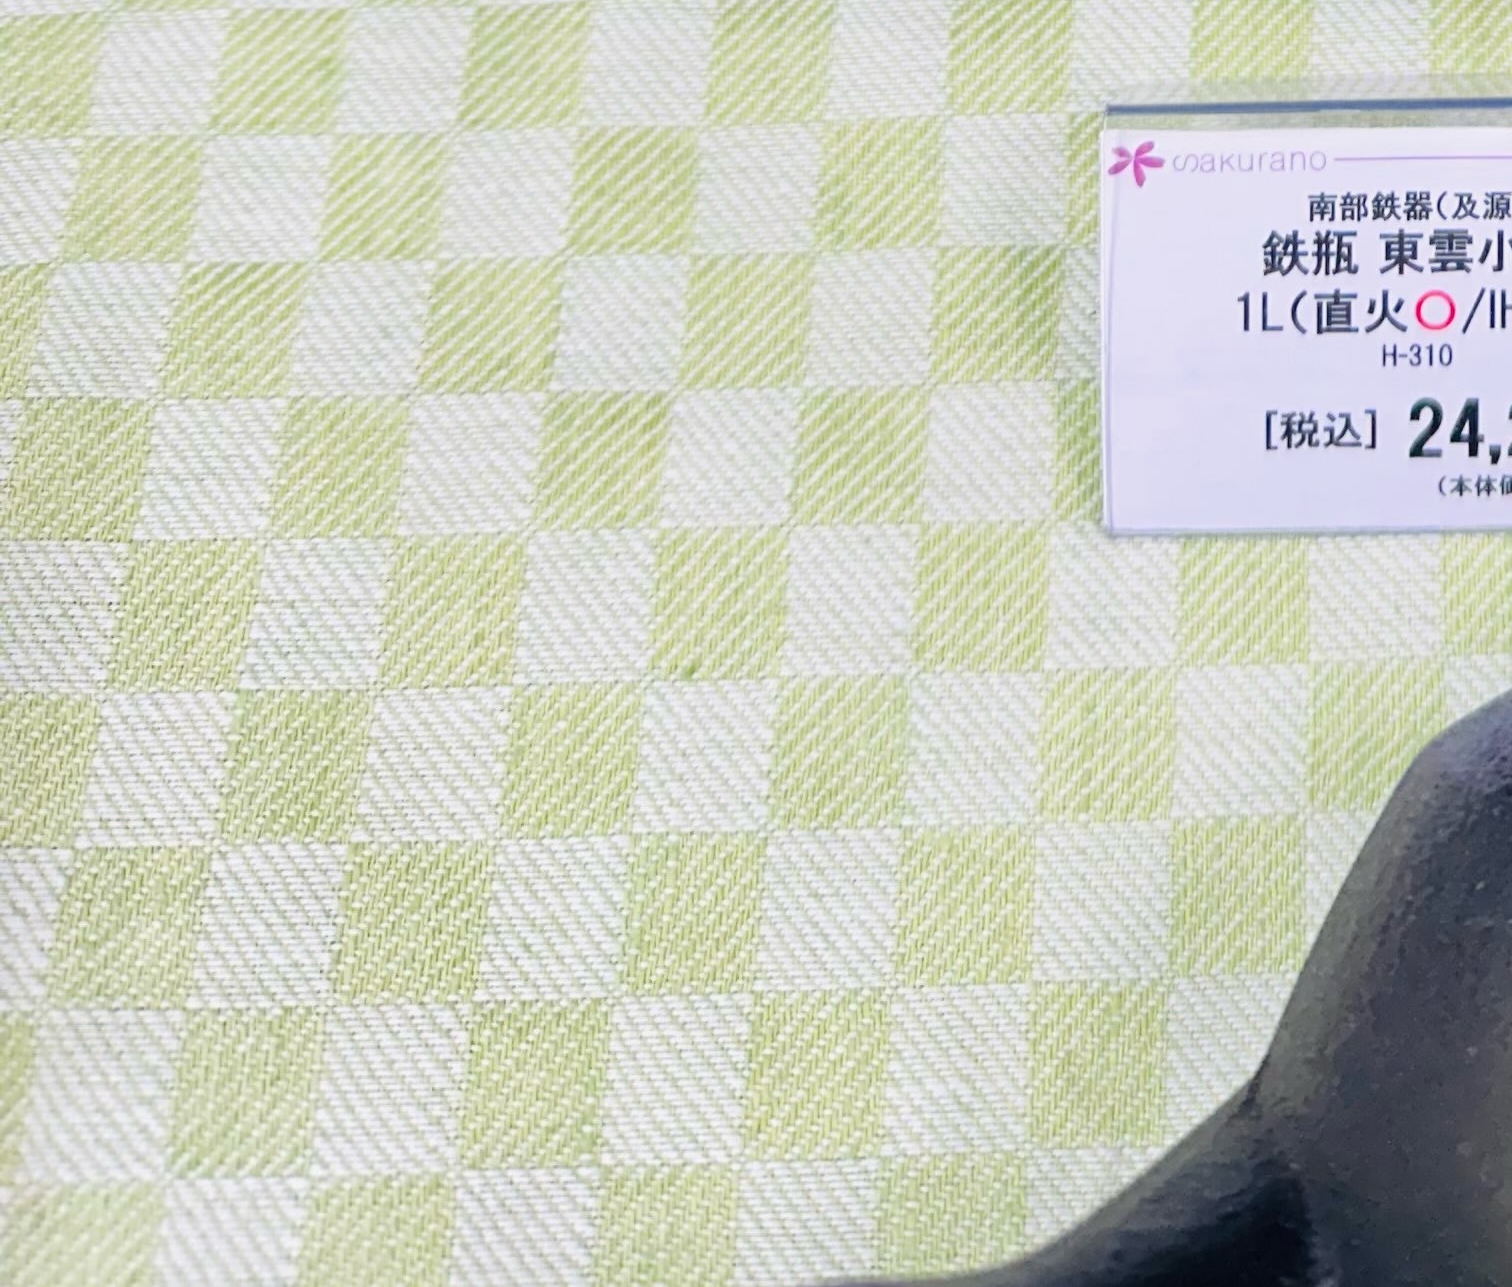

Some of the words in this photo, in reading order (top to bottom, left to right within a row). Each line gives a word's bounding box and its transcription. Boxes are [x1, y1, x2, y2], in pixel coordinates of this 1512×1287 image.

[1262, 229, 1360, 277] 鉄瓶
[1381, 343, 1454, 368] H-310
[1265, 408, 1378, 451] [税込]
